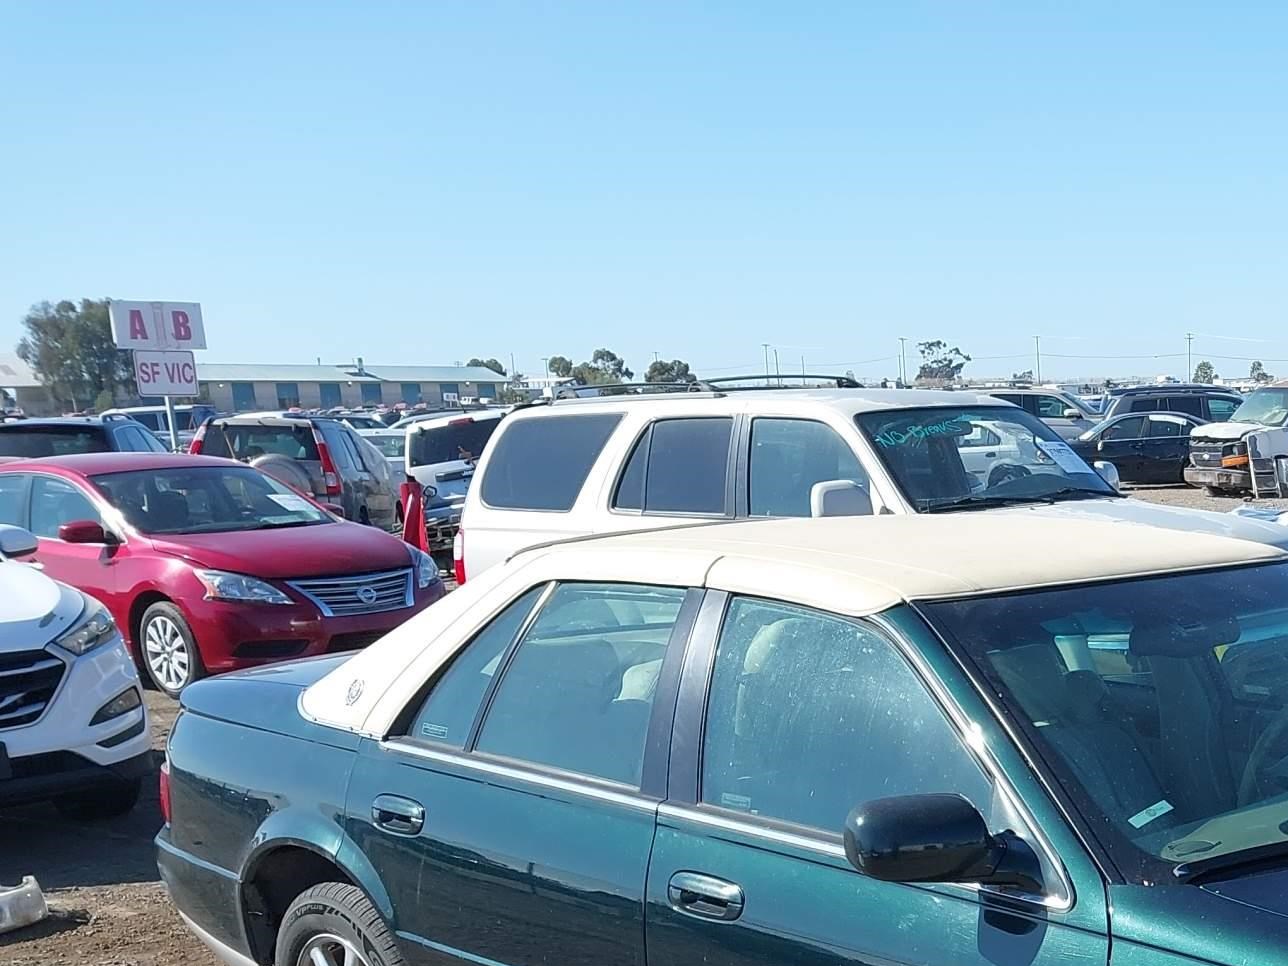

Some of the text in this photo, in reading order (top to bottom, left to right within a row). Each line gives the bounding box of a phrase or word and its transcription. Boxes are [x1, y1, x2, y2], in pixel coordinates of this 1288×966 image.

[128, 309, 192, 341] A B
[139, 362, 194, 384] SF VIC
